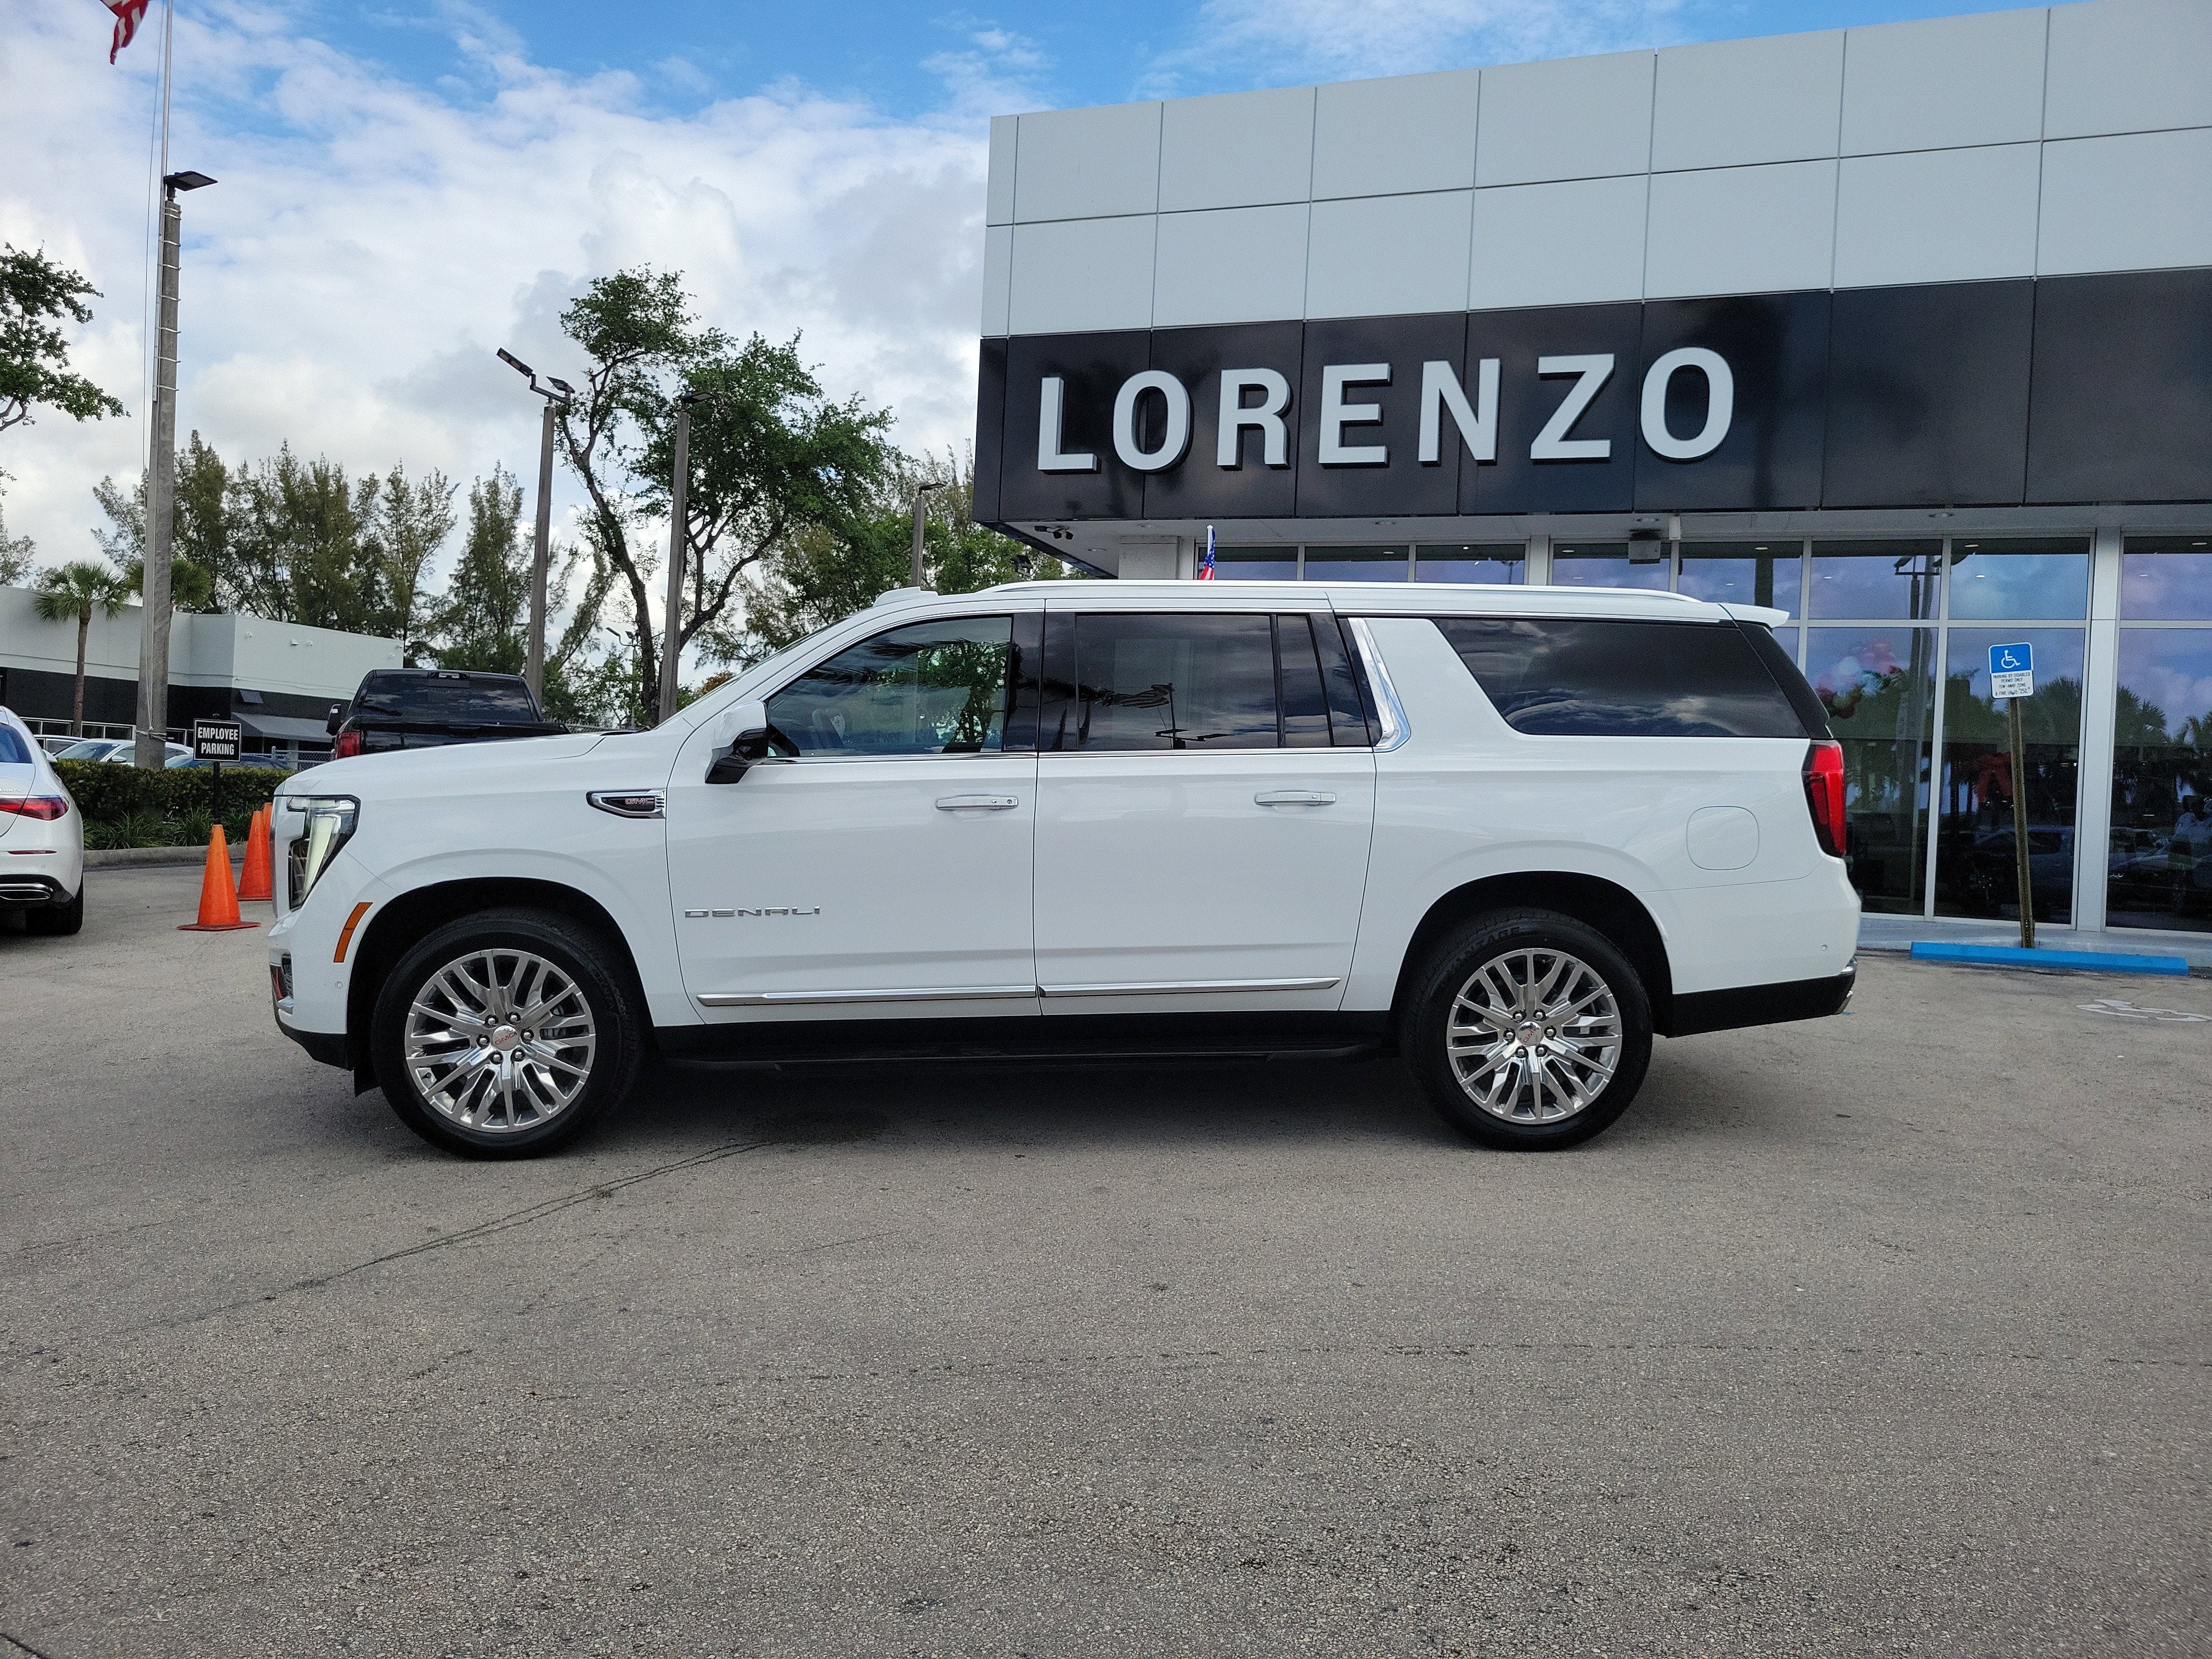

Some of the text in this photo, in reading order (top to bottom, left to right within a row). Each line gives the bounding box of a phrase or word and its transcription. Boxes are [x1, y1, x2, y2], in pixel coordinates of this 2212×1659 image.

[1037, 346, 1735, 472] LORENZO
[198, 726, 238, 740] EMPLOYEE
[201, 742, 234, 755] PARKING
[685, 905, 820, 918] DENALI
[494, 1031, 517, 1045] GMC
